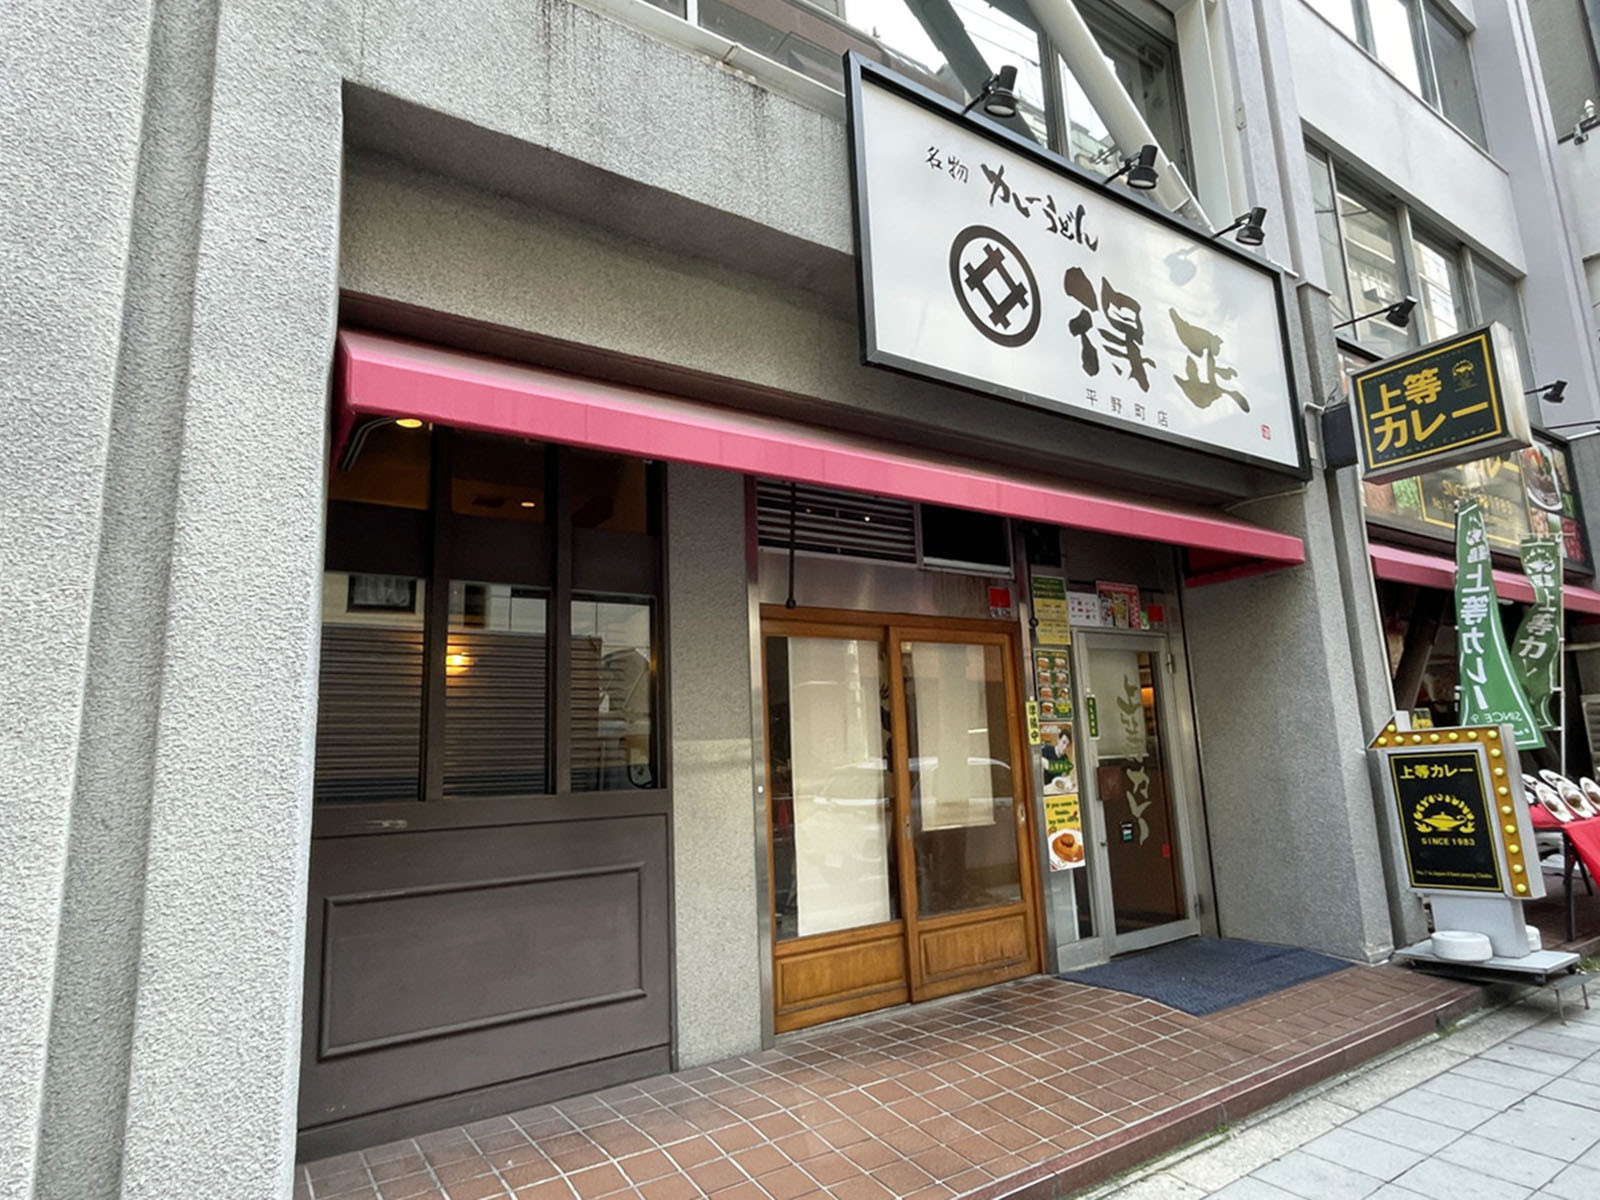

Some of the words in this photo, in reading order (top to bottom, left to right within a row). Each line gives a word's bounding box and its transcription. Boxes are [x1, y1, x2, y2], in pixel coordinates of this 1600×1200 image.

[924, 145, 969, 184] 名物
[1063, 265, 1251, 414] 得正
[1086, 387, 1169, 429] 平野町店
[1370, 366, 1443, 420] 上等
[1374, 401, 1489, 453] カレー
[1399, 763, 1474, 780] 上等カレー
[1421, 837, 1450, 847] SINCE
